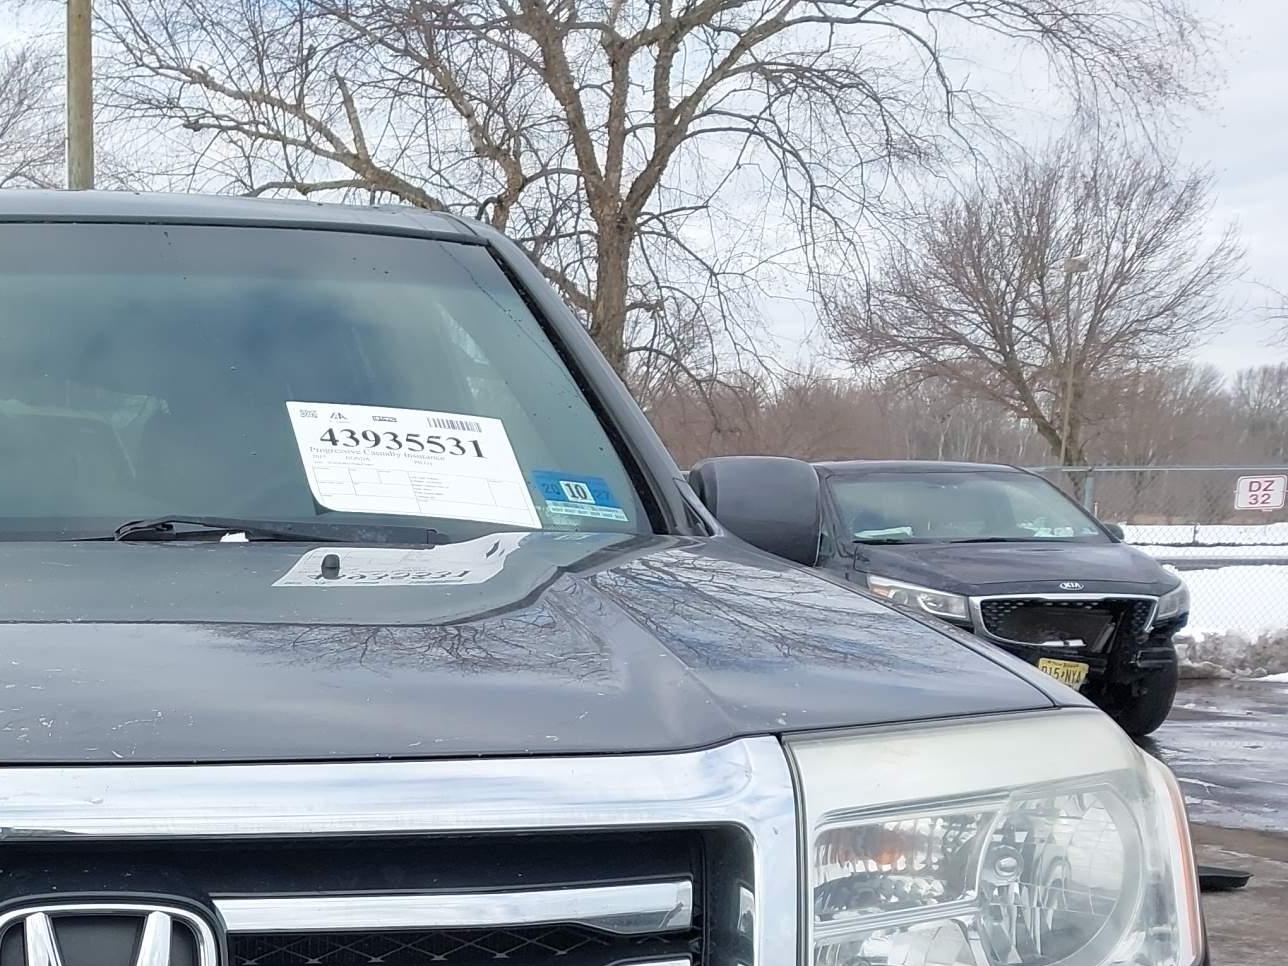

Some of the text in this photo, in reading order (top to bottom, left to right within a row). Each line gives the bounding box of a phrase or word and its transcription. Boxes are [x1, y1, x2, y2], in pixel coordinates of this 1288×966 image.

[320, 427, 488, 459] 43935531
[564, 483, 588, 500] 10
[1248, 480, 1275, 492] DZ
[1248, 494, 1271, 505] 32
